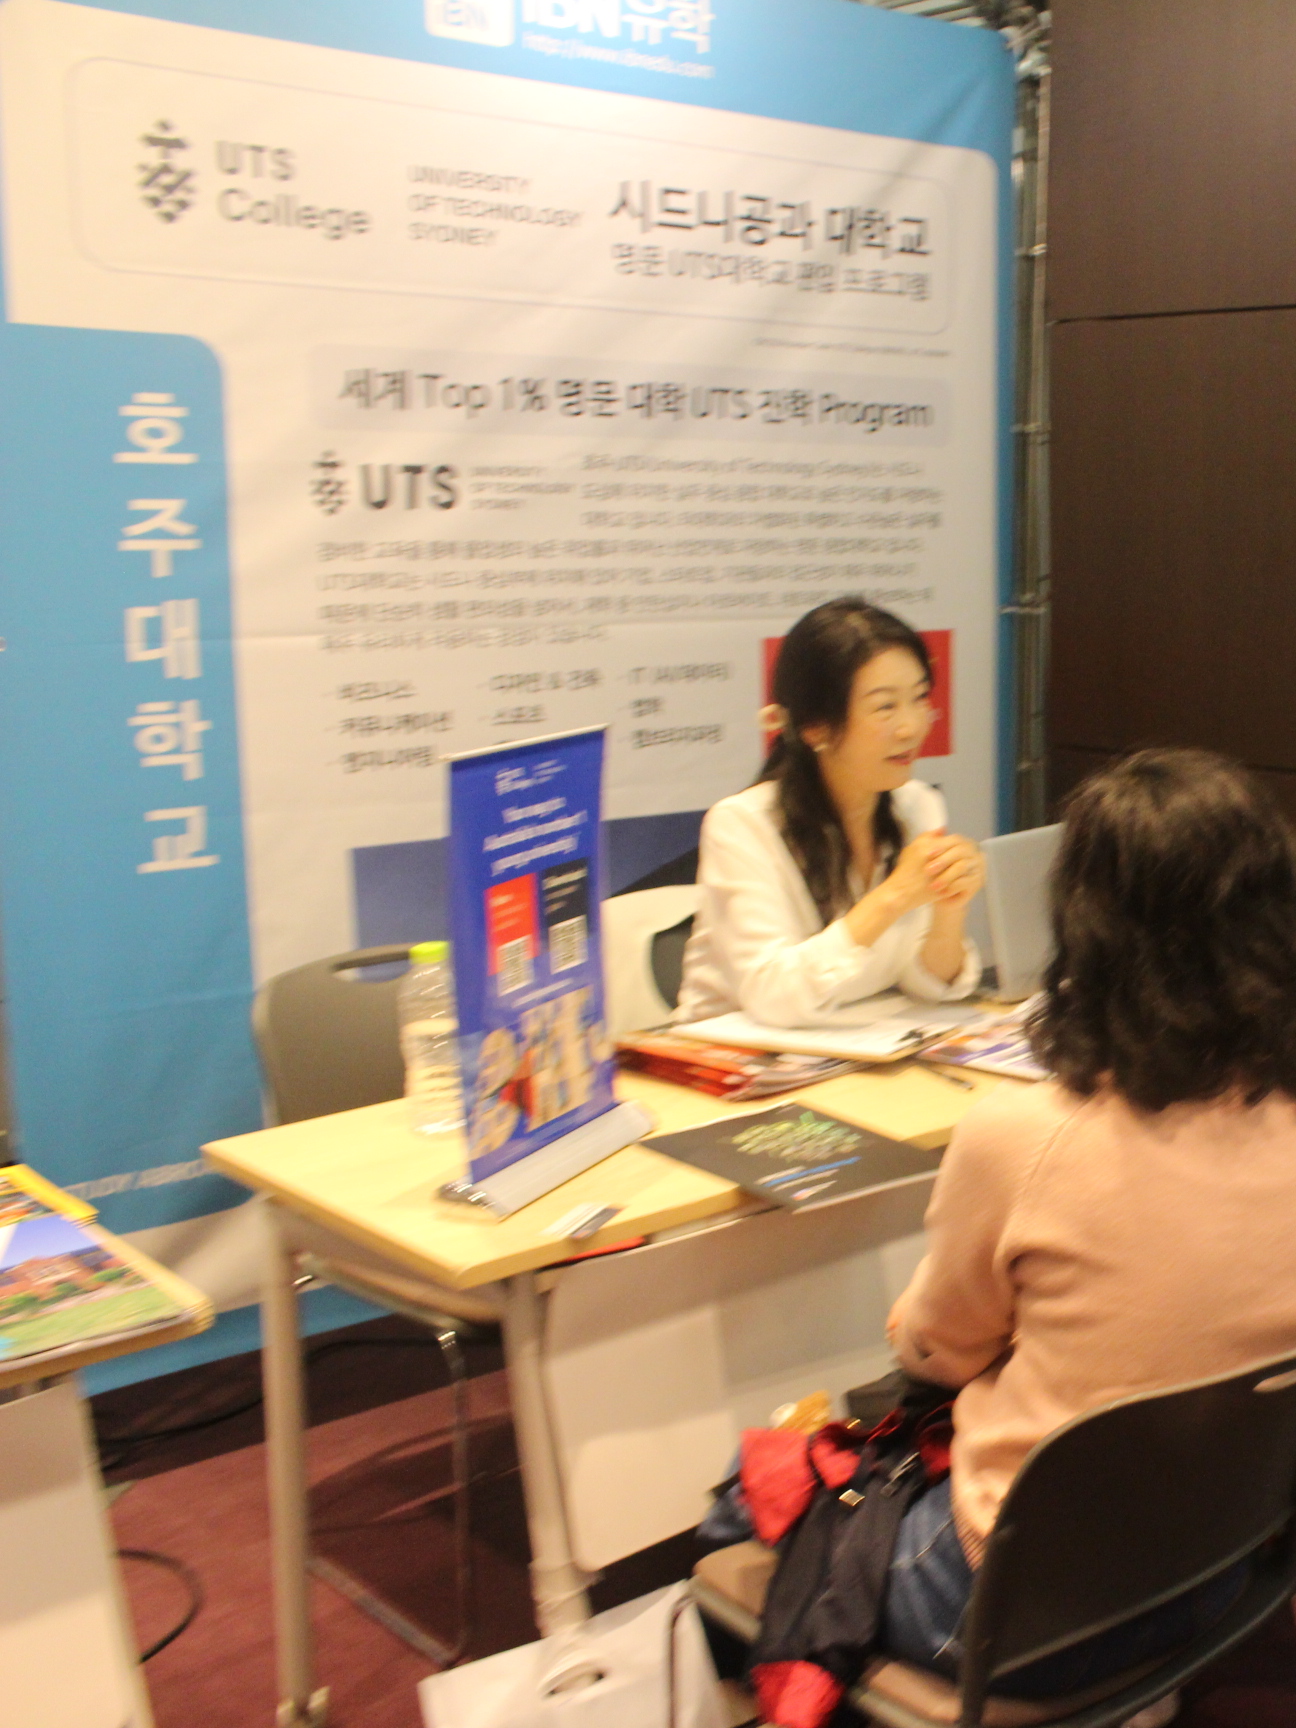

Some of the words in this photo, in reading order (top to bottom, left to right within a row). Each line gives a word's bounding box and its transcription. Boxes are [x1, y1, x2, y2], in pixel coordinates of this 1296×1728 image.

[215, 140, 296, 181] UTS
[407, 165, 532, 194] UNIVERSITY
[217, 187, 371, 240] College
[408, 193, 439, 212] OF
[443, 196, 585, 228] TECHNOLOGY
[608, 179, 815, 250] 시드니공과
[824, 206, 932, 259] 대학교
[408, 221, 500, 246] SYDNEY
[611, 243, 664, 277] 명문
[338, 368, 411, 411] 세계
[417, 373, 493, 420] Top
[497, 376, 549, 412] 1%
[557, 378, 619, 417] 명문
[626, 381, 687, 420] 대학
[690, 386, 750, 419] UTS
[818, 392, 936, 436] Program
[359, 463, 460, 511] UTS
[112, 391, 221, 875] 호주대학교
